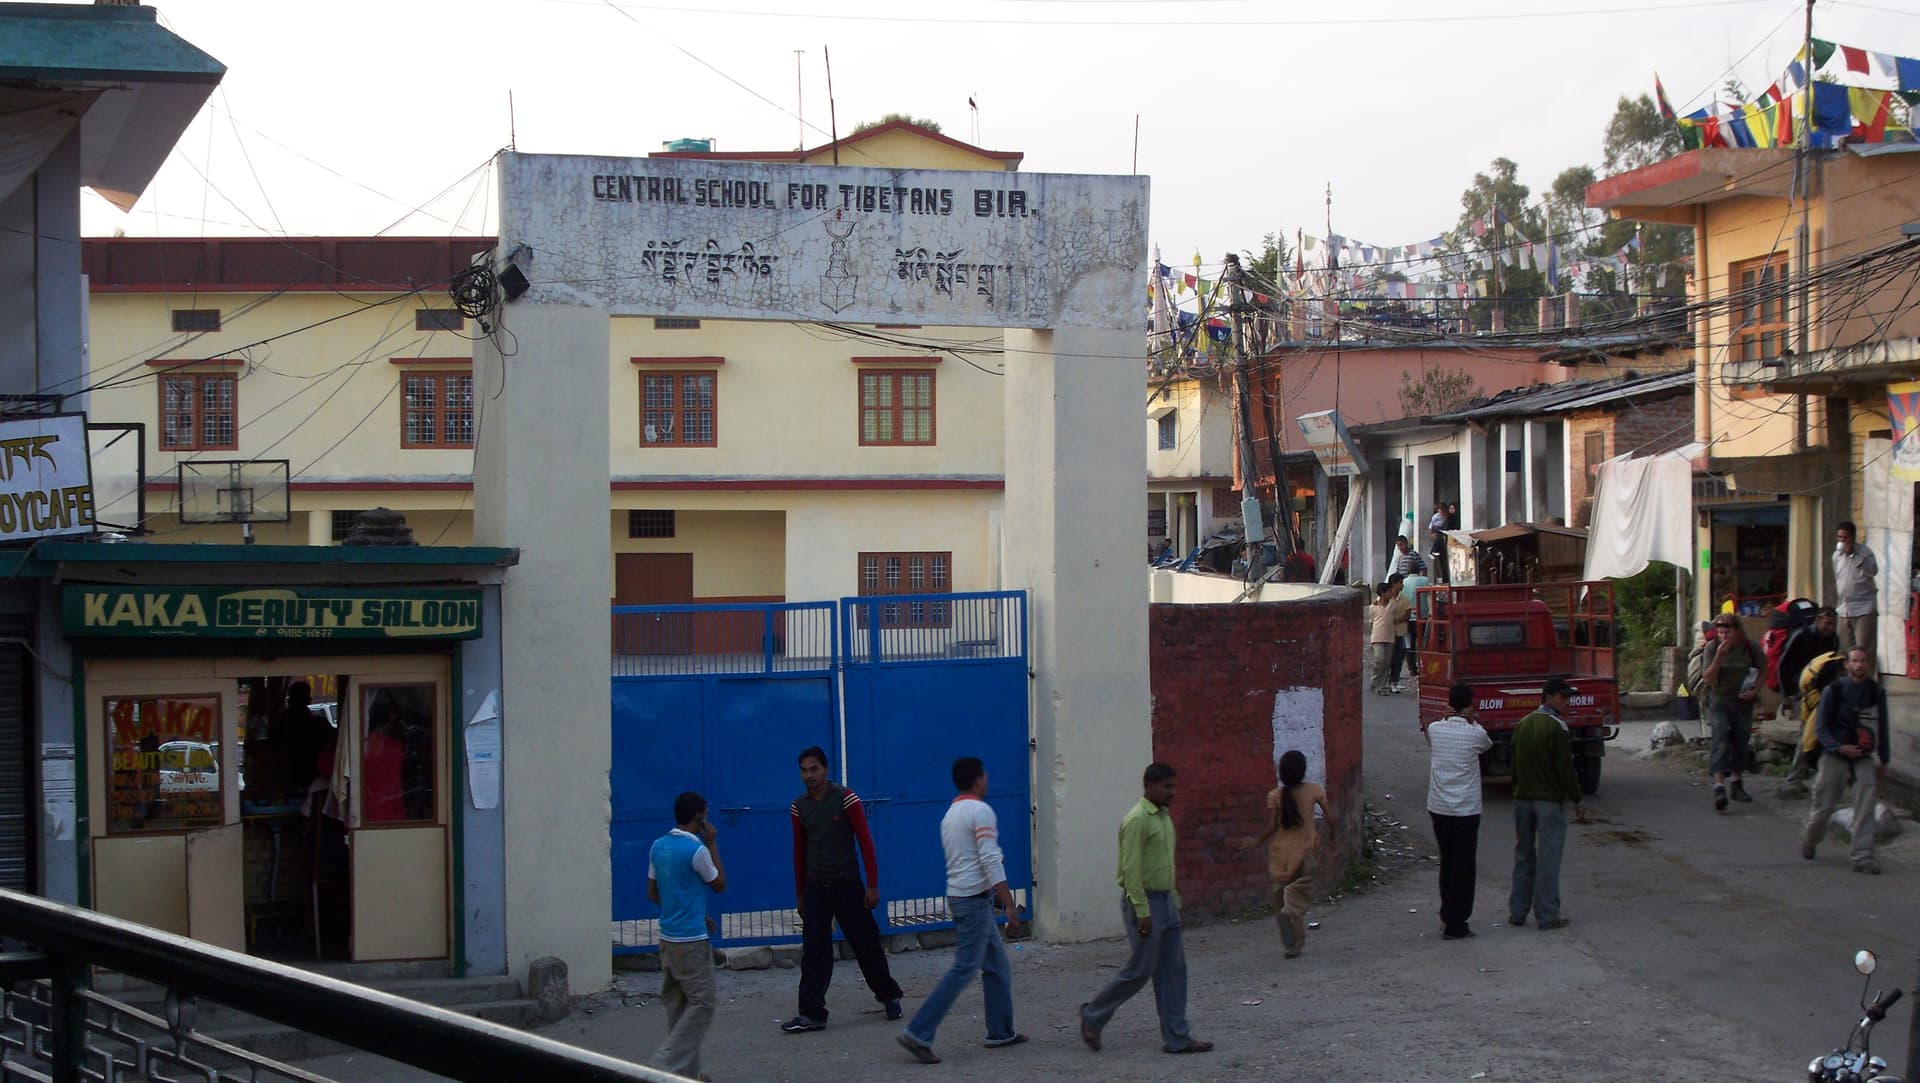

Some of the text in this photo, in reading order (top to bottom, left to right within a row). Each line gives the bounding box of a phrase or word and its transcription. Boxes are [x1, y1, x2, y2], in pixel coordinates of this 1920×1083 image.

[592, 175, 1039, 217] CENTRAL SCHOOL FOR TIBETANS BIR.
[84, 593, 477, 627] KAKA BEAUTY SALOON
[1479, 699, 1504, 710] BLOW
[1569, 695, 1594, 706] HORN
[112, 700, 213, 743] KAKA
[112, 751, 166, 770] BEAUTY
